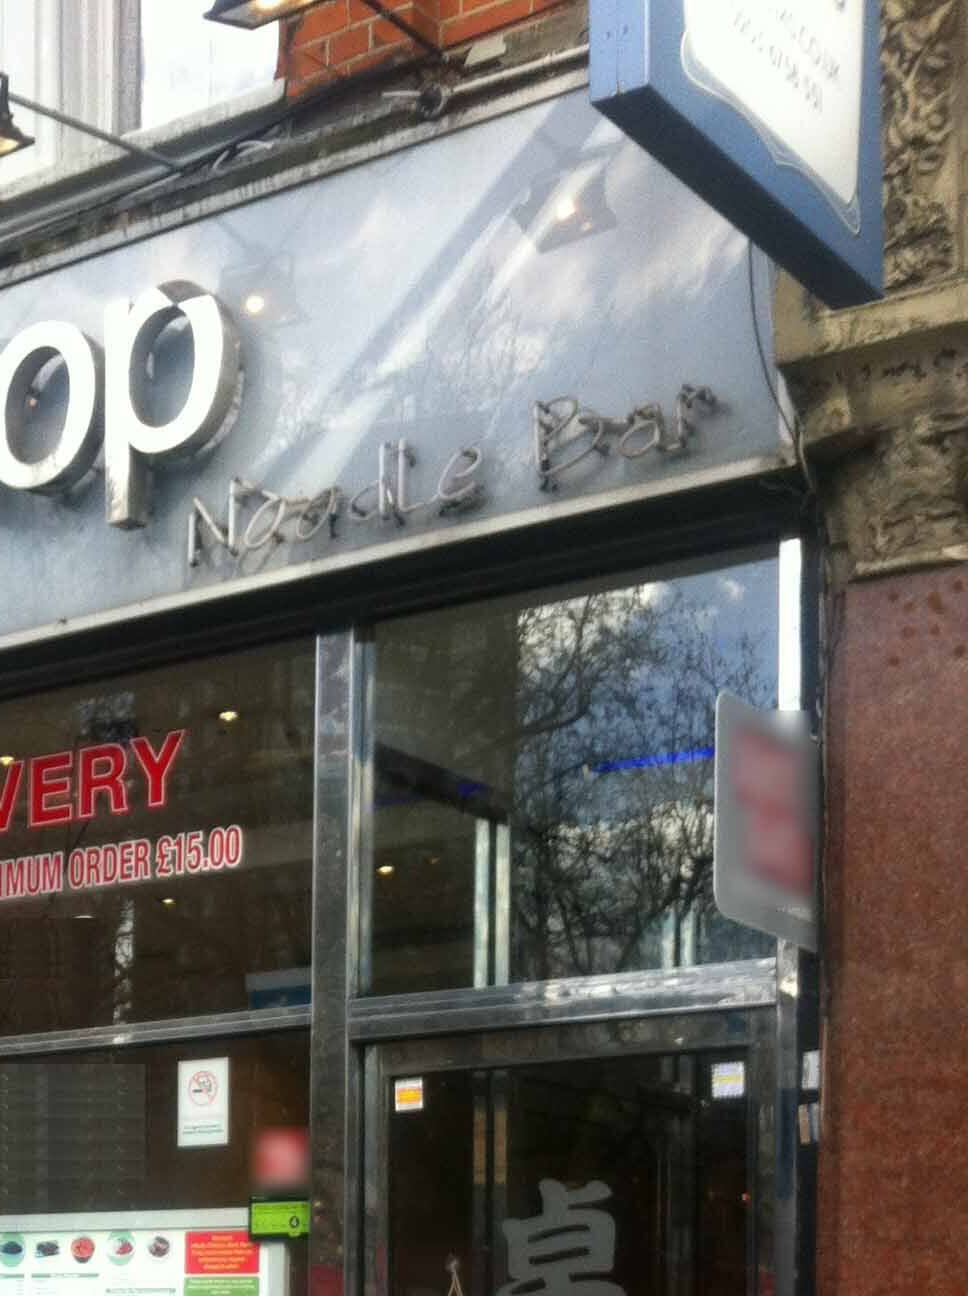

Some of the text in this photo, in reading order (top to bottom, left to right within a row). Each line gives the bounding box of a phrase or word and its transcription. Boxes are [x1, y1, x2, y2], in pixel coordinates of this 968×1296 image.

[187, 383, 719, 567] Noodle Bar
[68, 838, 152, 889] ORDER
[156, 823, 243, 877] £15.00
